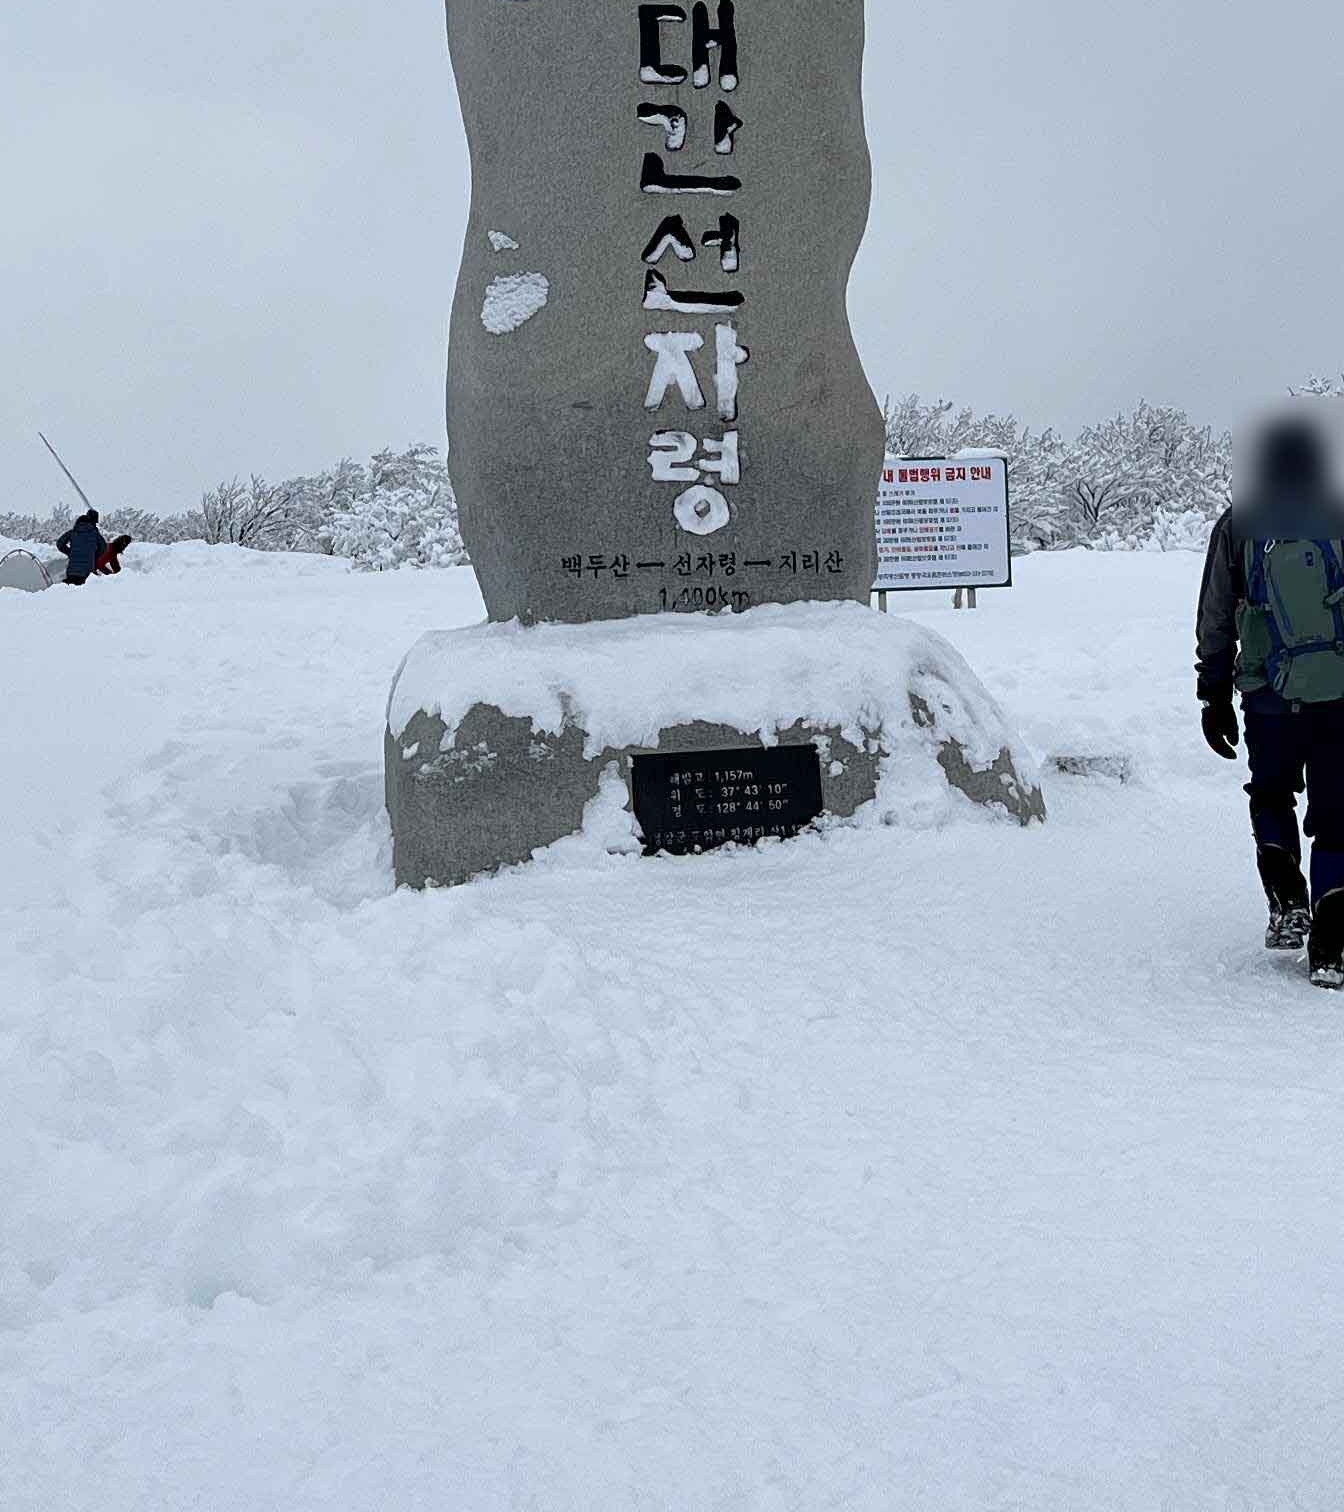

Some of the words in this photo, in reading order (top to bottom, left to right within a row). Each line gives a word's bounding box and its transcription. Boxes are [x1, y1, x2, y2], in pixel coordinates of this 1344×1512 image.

[640, 211, 749, 537] 선자령
[898, 467, 941, 483] 불법행위
[944, 466, 966, 481] 금지
[970, 466, 992, 481] 안내
[561, 553, 631, 579] 백두산
[672, 552, 738, 578] 선자령
[778, 550, 844, 575] 지리산
